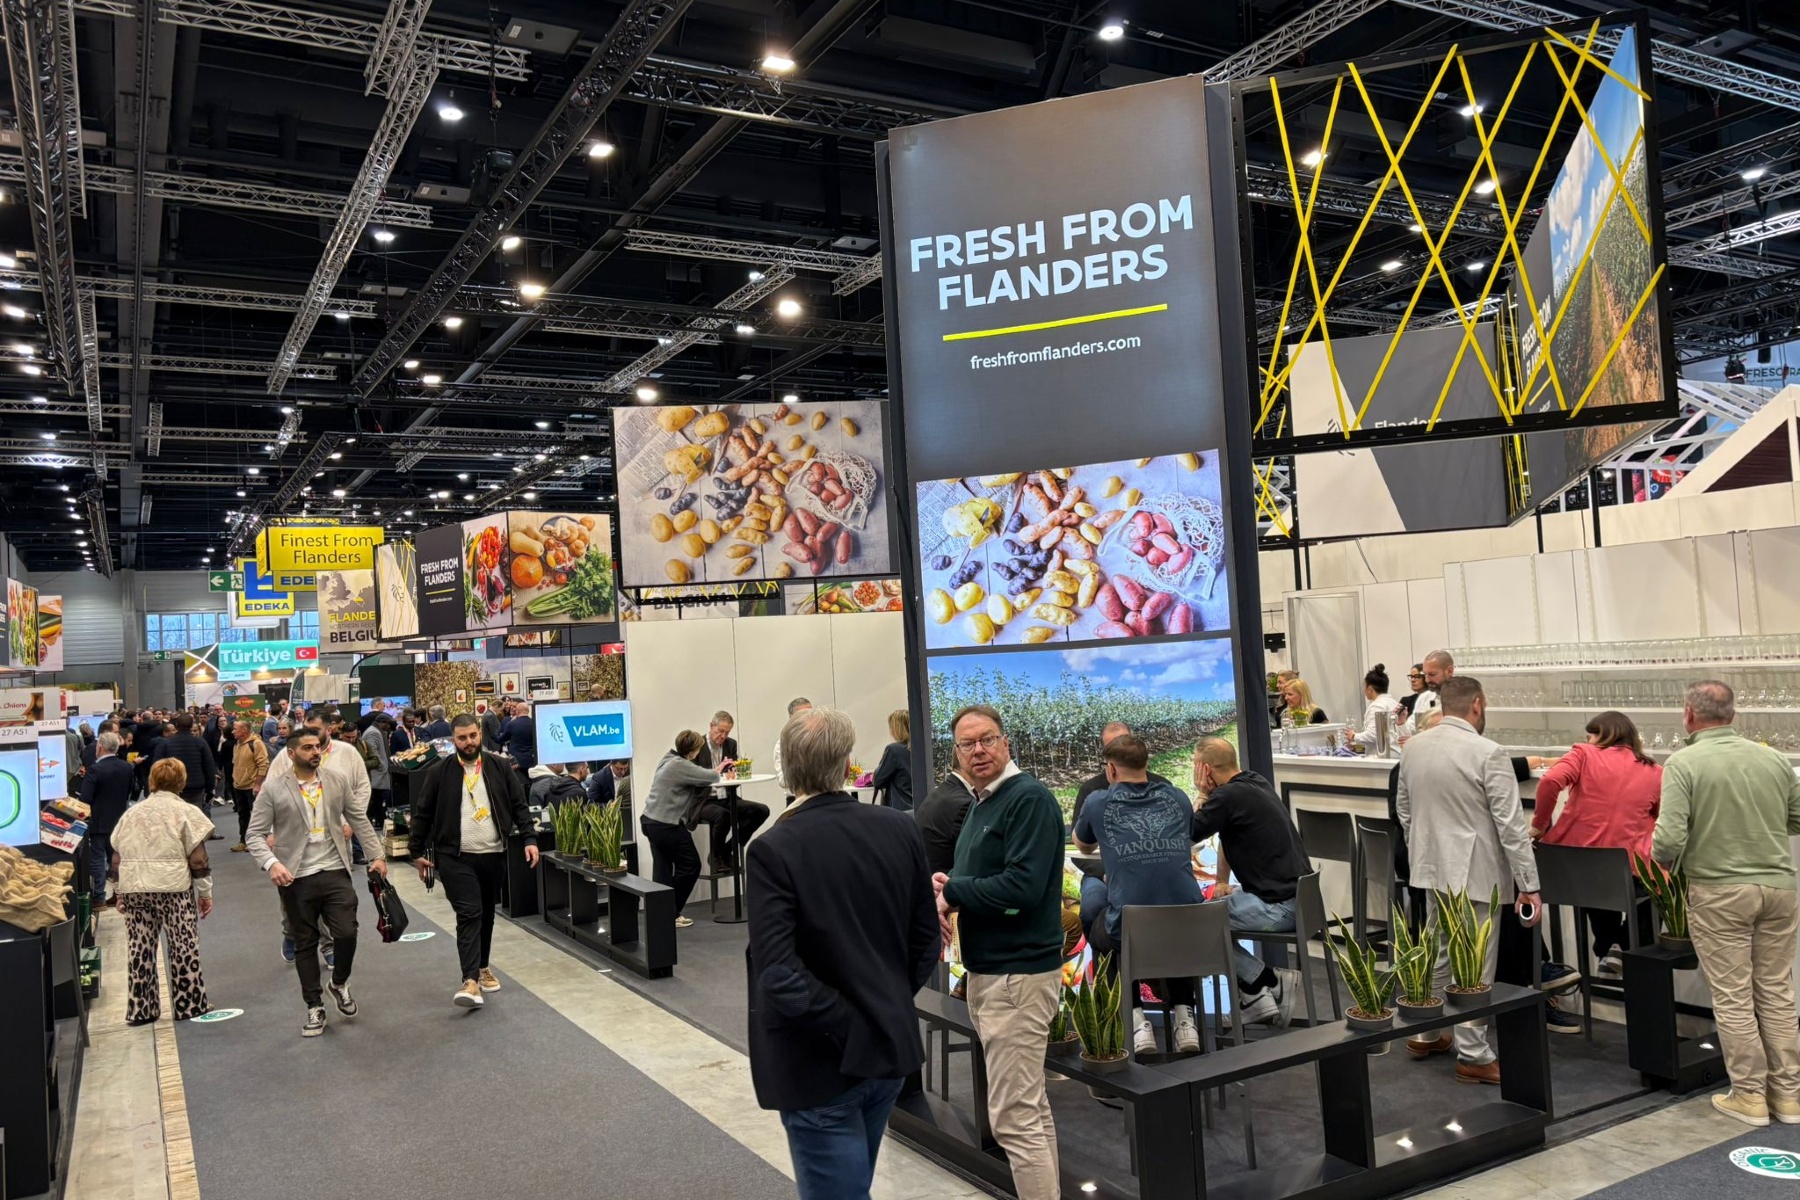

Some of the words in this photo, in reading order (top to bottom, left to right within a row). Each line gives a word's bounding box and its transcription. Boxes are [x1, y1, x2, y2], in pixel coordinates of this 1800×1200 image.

[910, 220, 1046, 273] FRESH
[1062, 195, 1194, 250] FROM
[938, 244, 1169, 310] FLANDERS
[970, 334, 1141, 370] freshfromflanders.com
[280, 533, 329, 547] Finest
[334, 533, 373, 547] From
[293, 550, 361, 564] Flanders
[420, 561, 440, 574] FRESH
[440, 557, 459, 571] FROM
[280, 575, 317, 586] EDE
[424, 571, 456, 586] FLANDERS
[245, 602, 290, 611] EDEKA
[329, 611, 376, 623] FLANDE
[330, 629, 378, 643] BELGIU
[220, 647, 292, 664] Türkiye
[1, 729, 12, 737] 27
[13, 728, 28, 736] A51
[573, 724, 620, 737] VLAM.be
[1114, 838, 1187, 857] VANQUISH
